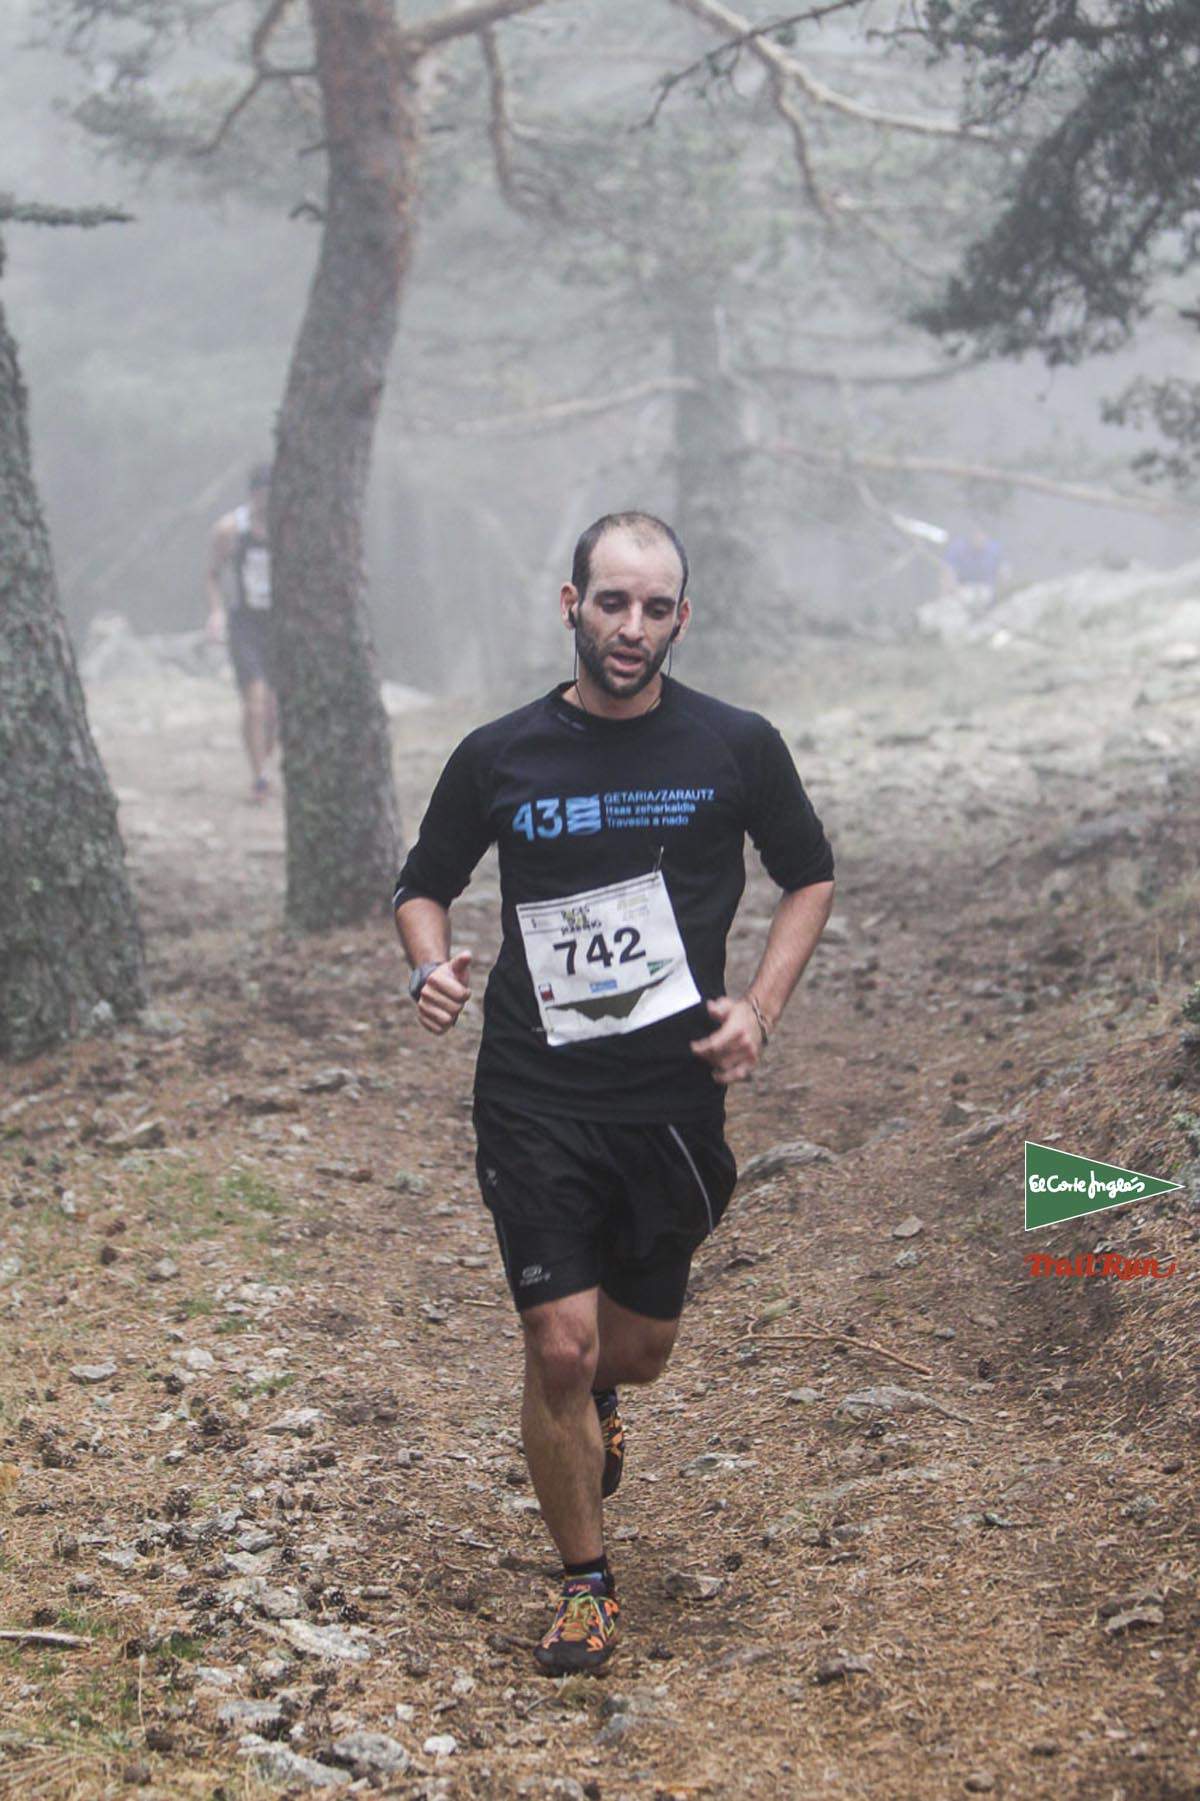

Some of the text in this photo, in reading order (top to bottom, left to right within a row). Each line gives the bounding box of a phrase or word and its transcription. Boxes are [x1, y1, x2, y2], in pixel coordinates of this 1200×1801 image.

[604, 789, 714, 802] GETARIA/ZARAUTZ
[512, 797, 563, 842] 43
[662, 814, 689, 826] nado
[553, 927, 647, 976] 742
